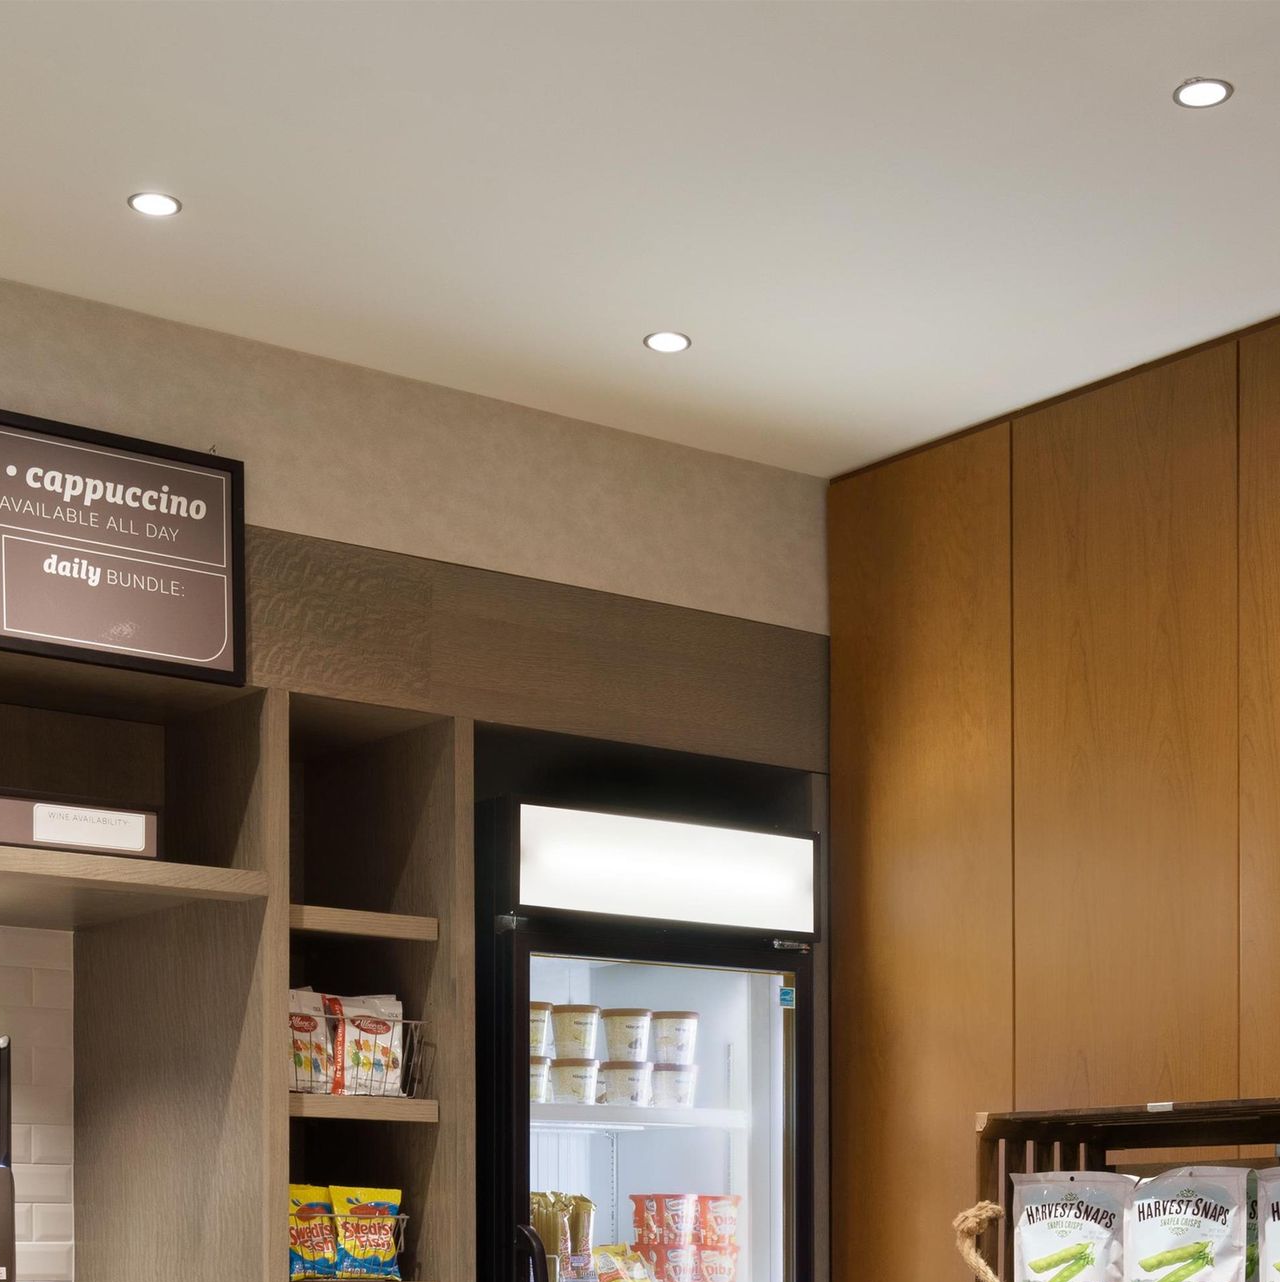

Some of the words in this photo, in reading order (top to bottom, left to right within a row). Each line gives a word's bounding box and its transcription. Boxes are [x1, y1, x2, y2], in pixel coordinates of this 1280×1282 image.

[25, 463, 207, 521] cappuccino
[0, 495, 99, 529] AVAILABLE
[106, 516, 139, 536] ALL
[145, 523, 179, 543] DAY
[43, 553, 101, 587] daily
[107, 568, 186, 597] BUNDLE:
[48, 811, 70, 821] WINE
[72, 814, 129, 826] AVAILABILITY
[1026, 1202, 1075, 1225] HARVEST
[1074, 1200, 1116, 1230] SNAPS
[1137, 1199, 1190, 1222] HARVEST
[1192, 1198, 1230, 1226] SNAPS
